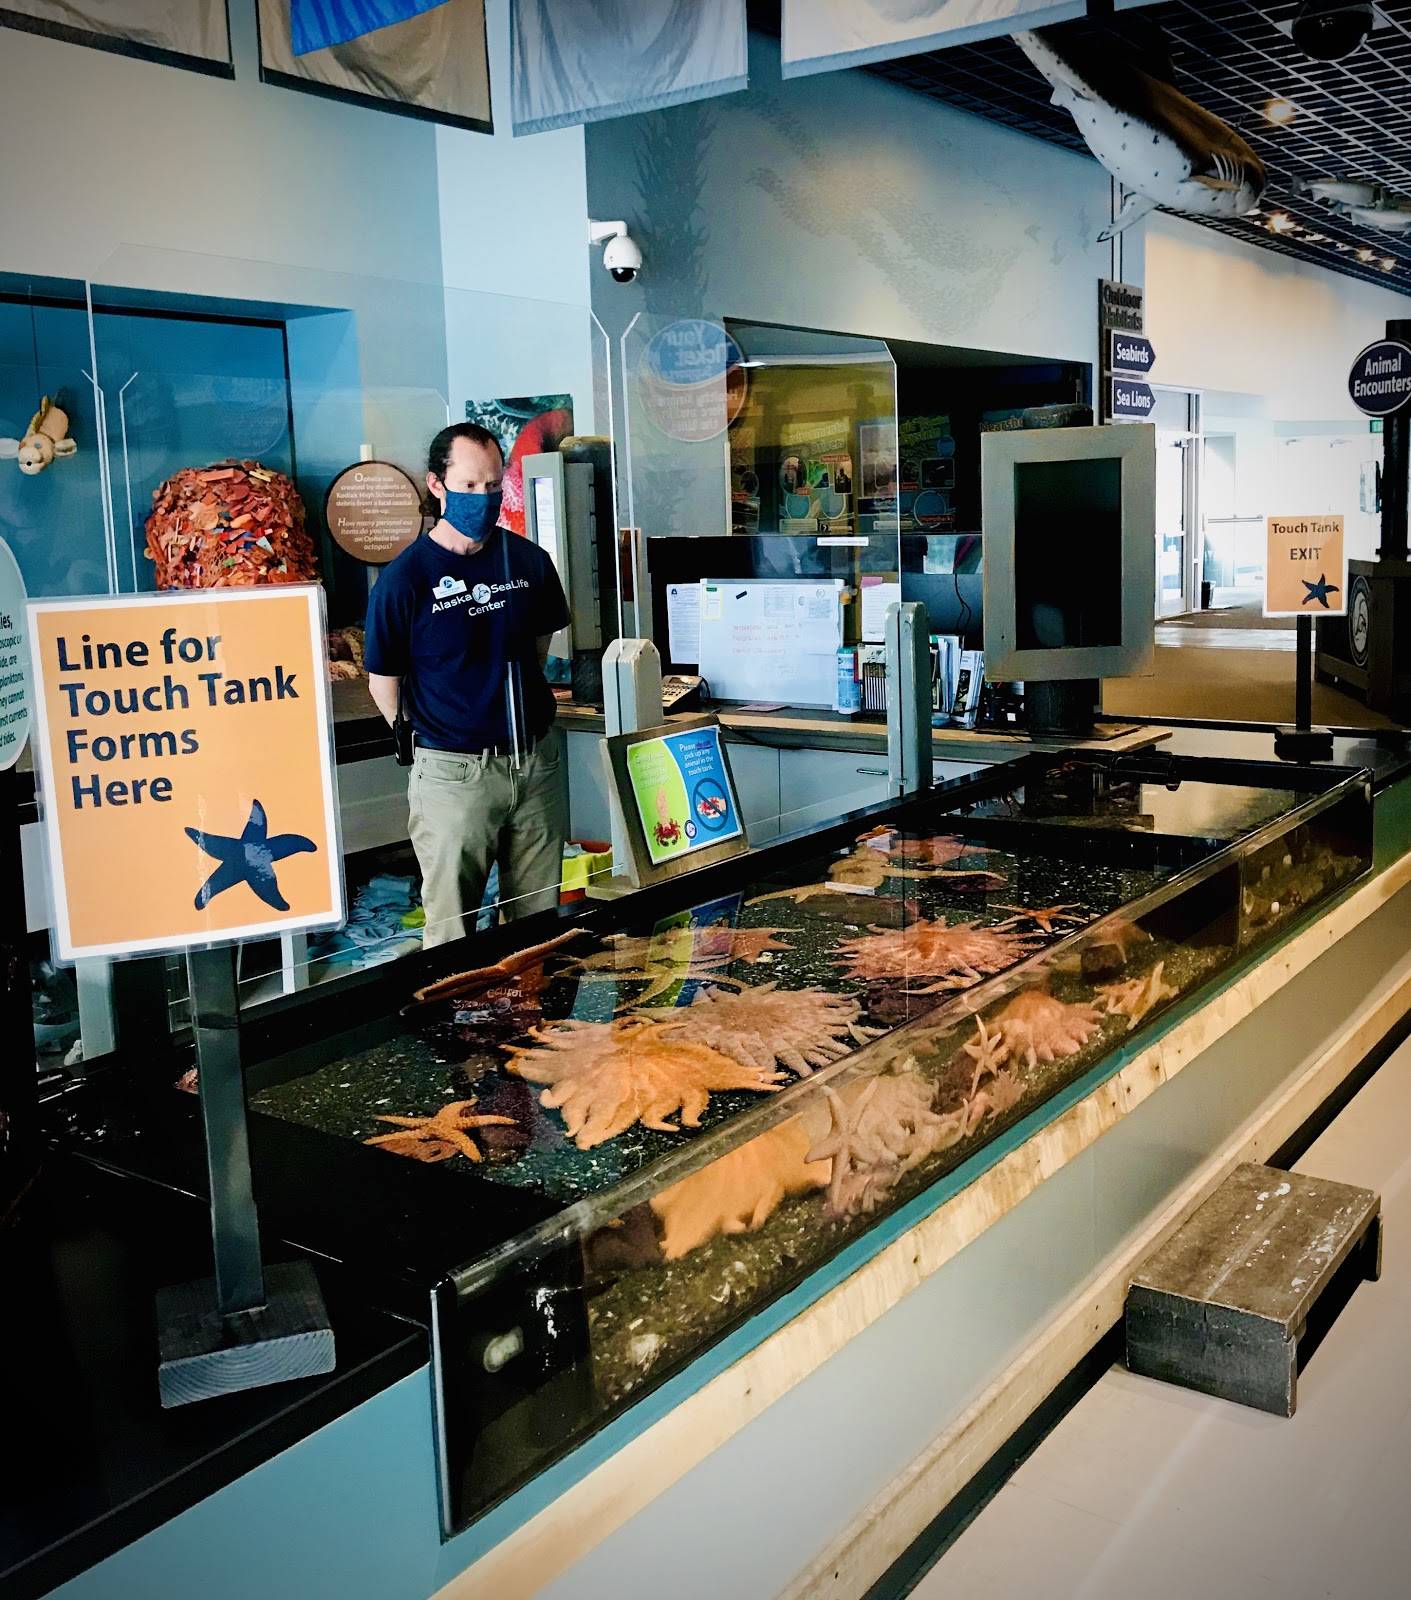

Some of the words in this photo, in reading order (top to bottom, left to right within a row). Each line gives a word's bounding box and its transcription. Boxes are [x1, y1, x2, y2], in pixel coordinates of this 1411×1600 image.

[1103, 284, 1142, 309] Outdoor
[1104, 305, 1142, 329] Habitats
[1116, 343, 1149, 364] Seabirds
[1364, 352, 1402, 376] Animal
[1354, 376, 1411, 397] Encounters
[1116, 388, 1130, 406] Sea
[1131, 390, 1151, 409] Lions
[1271, 522, 1308, 534] Touch
[1310, 521, 1339, 533] Tank
[363, 543, 393, 551] octopus?
[1290, 547, 1322, 560] EXIT
[431, 594, 473, 614] Alaska
[490, 579, 530, 594] SeaLife
[468, 599, 506, 617] Center
[56, 634, 149, 672] Line
[159, 628, 222, 665] for
[59, 675, 189, 717] Touch
[198, 665, 300, 707] Tank
[66, 728, 200, 764] Forms
[679, 743, 696, 752] Please
[684, 752, 694, 761] pick
[684, 757, 700, 768] animal
[71, 774, 173, 810] Here
